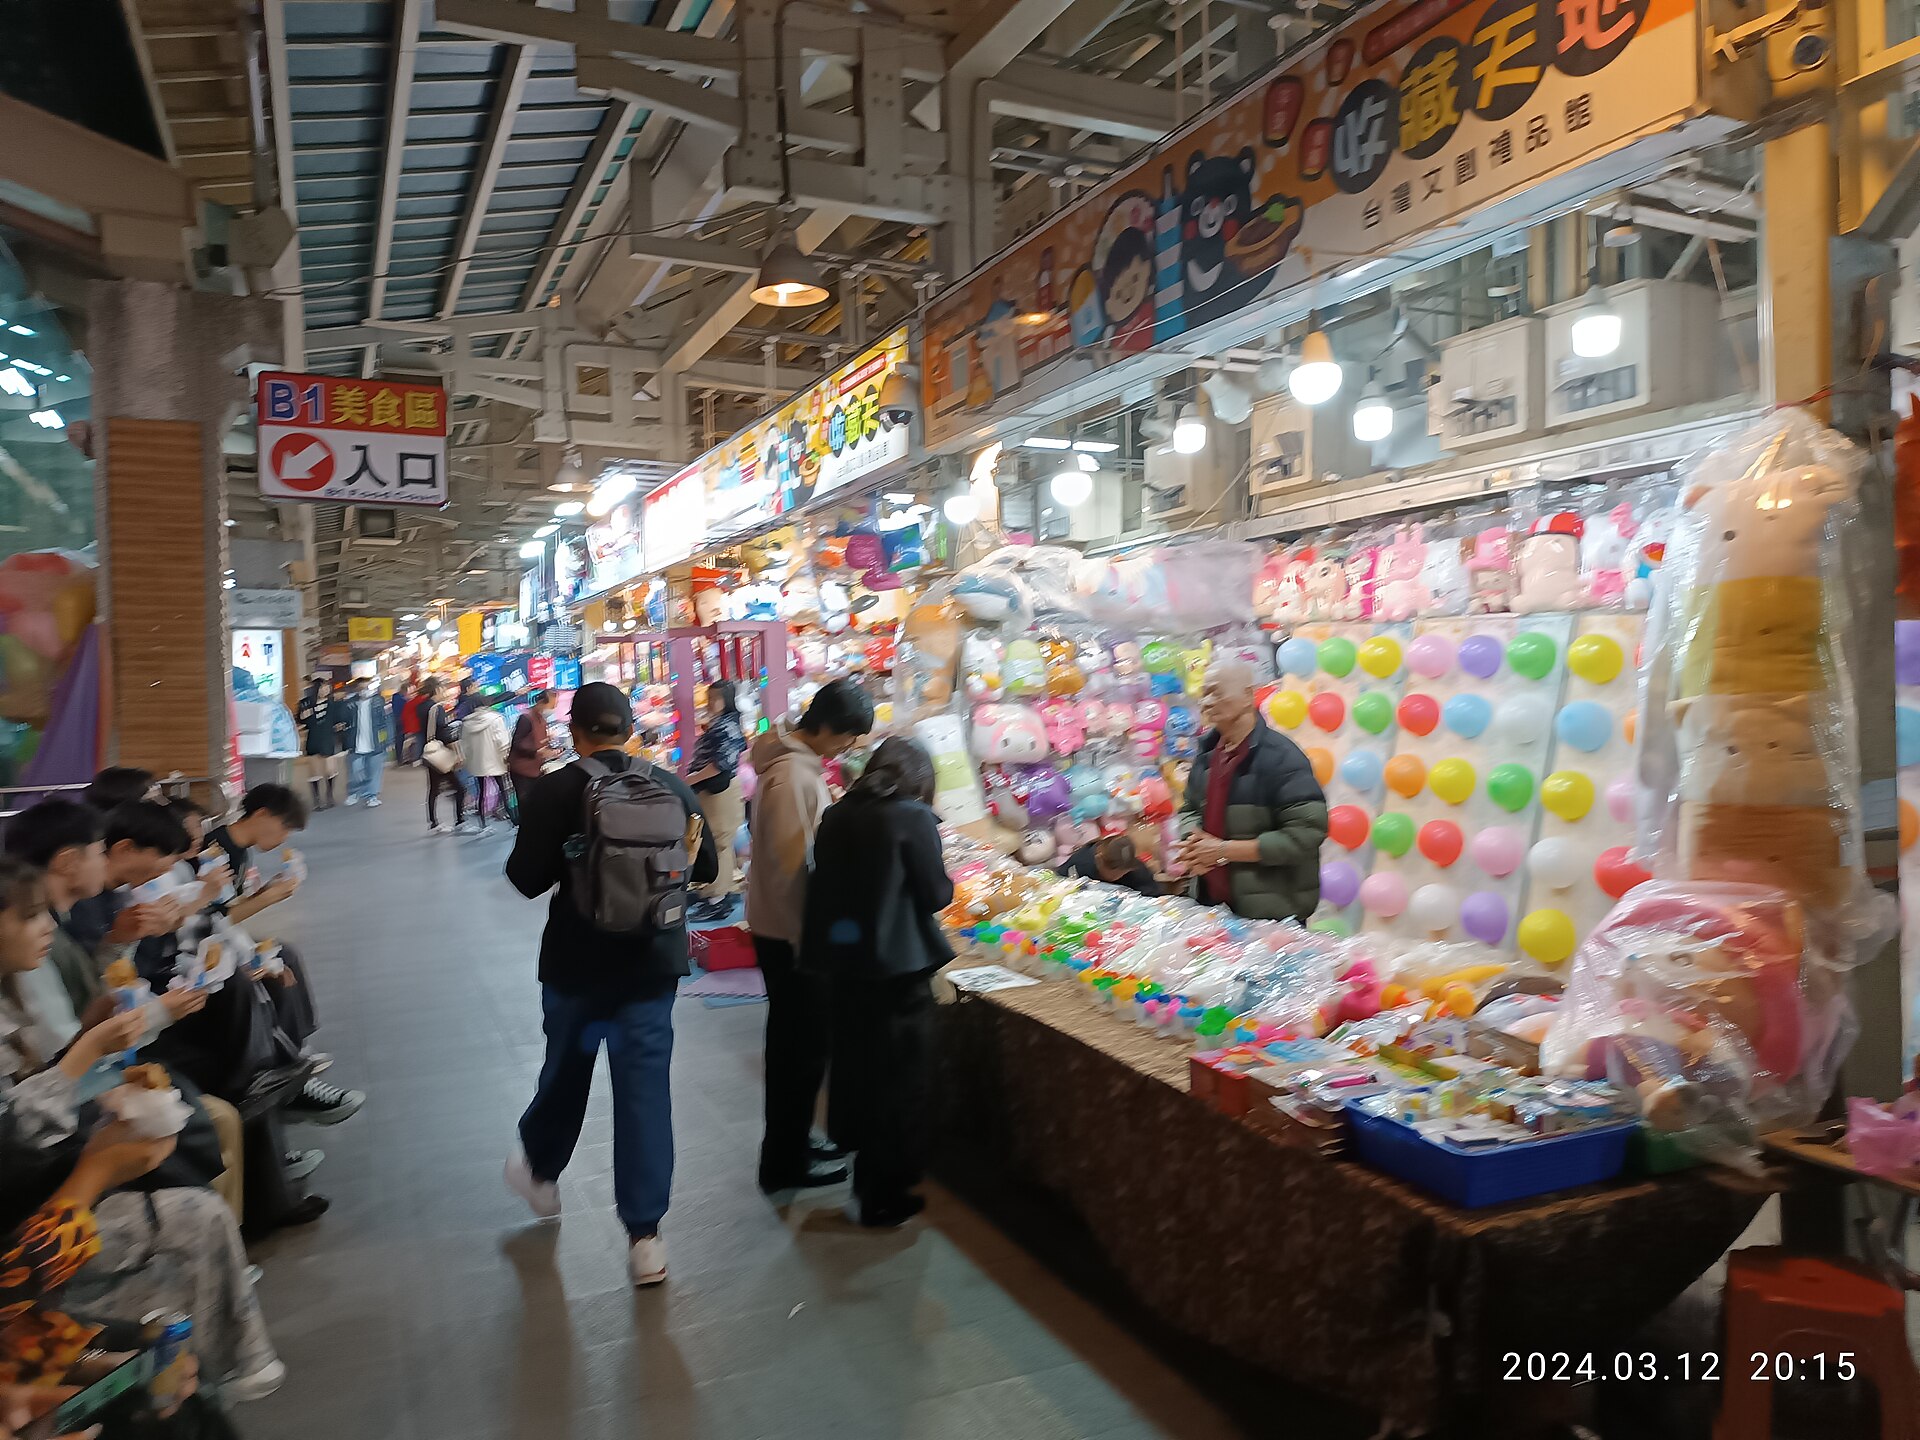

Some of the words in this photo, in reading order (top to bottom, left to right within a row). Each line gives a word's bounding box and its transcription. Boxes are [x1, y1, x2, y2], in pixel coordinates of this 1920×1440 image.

[1334, 0, 1636, 178] 收藏天地
[342, 444, 437, 489] 入口
